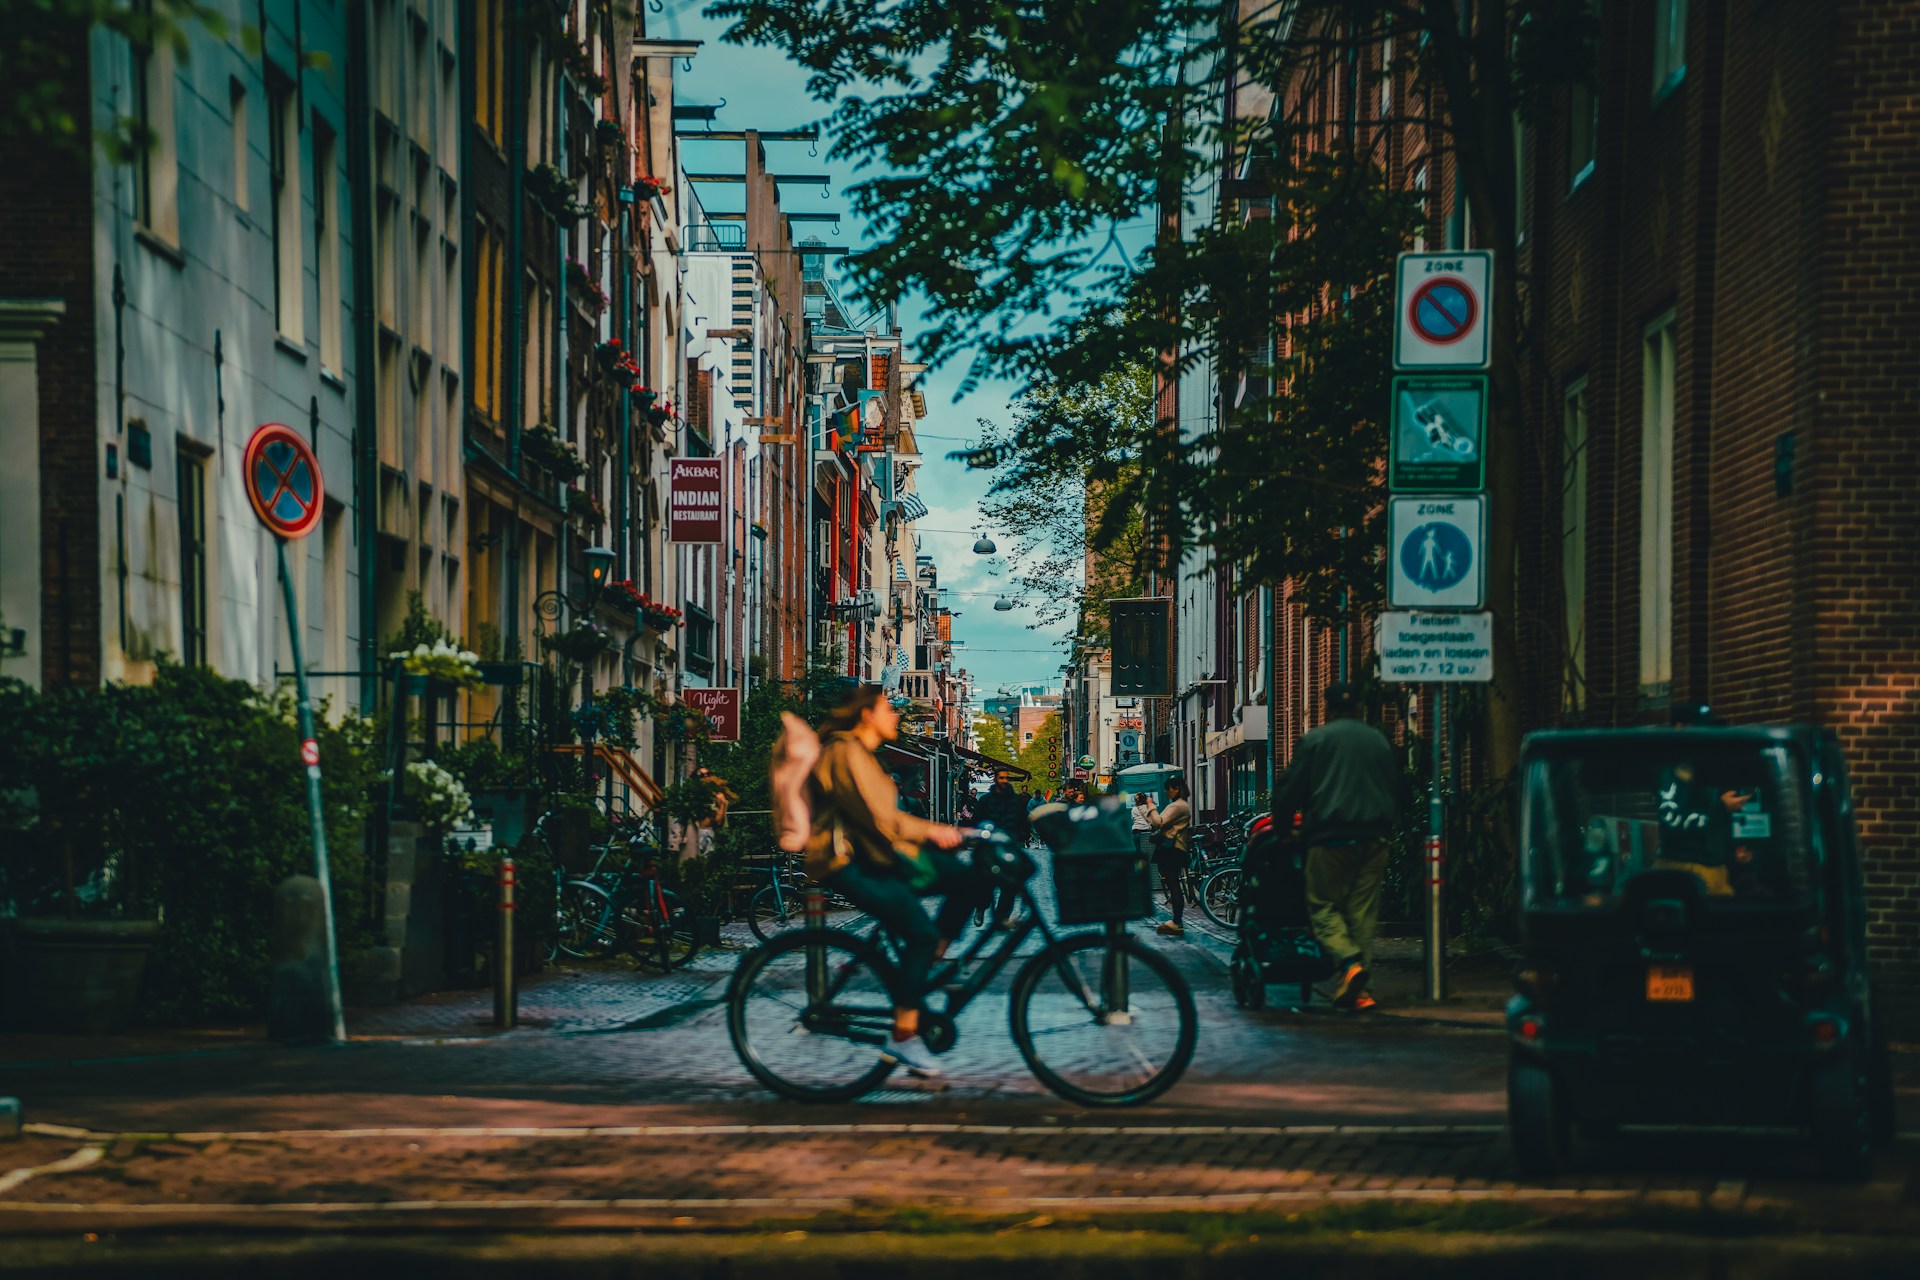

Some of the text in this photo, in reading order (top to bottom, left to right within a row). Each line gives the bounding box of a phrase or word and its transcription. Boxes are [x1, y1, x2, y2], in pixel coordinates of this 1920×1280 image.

[1425, 260, 1464, 273] ZONE
[672, 463, 719, 480] AKBAR
[672, 490, 719, 506] INDIAN
[672, 509, 719, 521] RESTAURANT
[1417, 503, 1454, 515] ZONE
[1398, 631, 1475, 645] toegestaan
[1423, 649, 1441, 658] en
[1444, 647, 1489, 658] lossen
[1391, 664, 1416, 674] van
[1439, 662, 1455, 674] 12
[692, 690, 730, 711] Night
